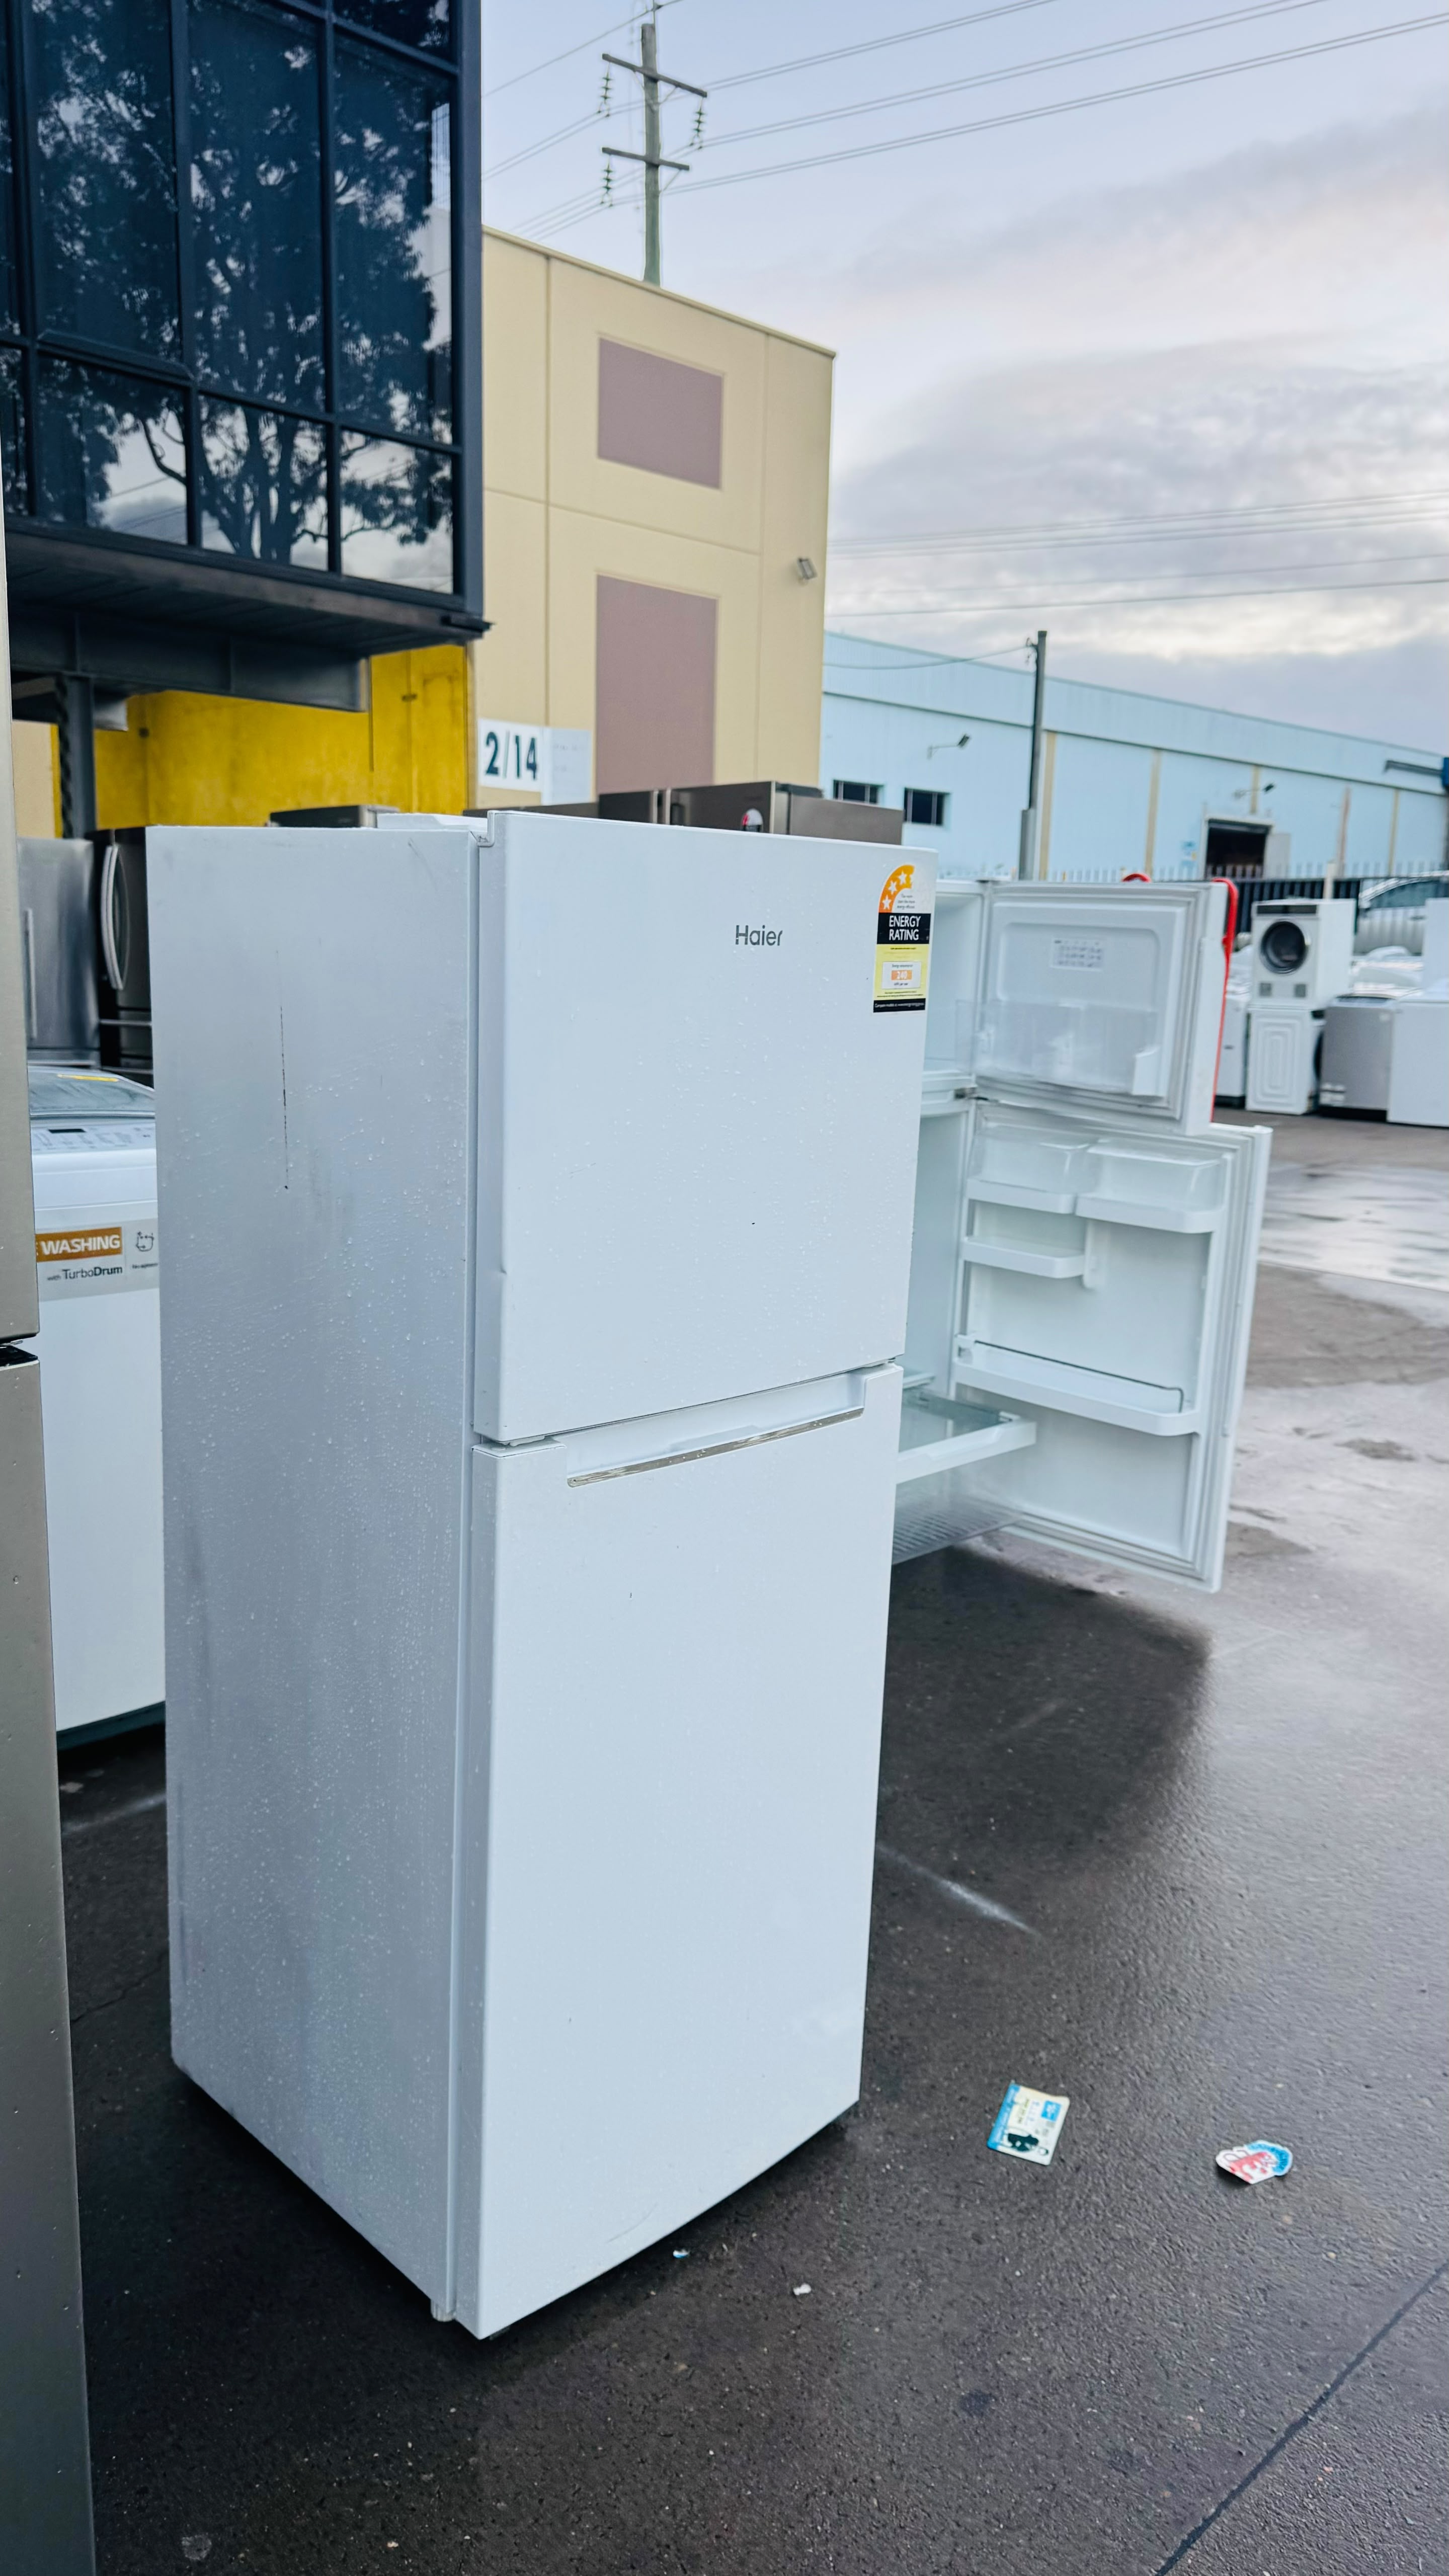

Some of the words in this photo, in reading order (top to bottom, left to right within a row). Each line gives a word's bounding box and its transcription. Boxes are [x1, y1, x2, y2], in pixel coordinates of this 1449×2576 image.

[486, 731, 537, 780] 2/14
[889, 915, 921, 927] ENERGY
[736, 925, 783, 946] Haier
[889, 929, 919, 941] RATING
[41, 1235, 120, 1255] WASHING
[62, 1266, 123, 1280] TurboDrum
